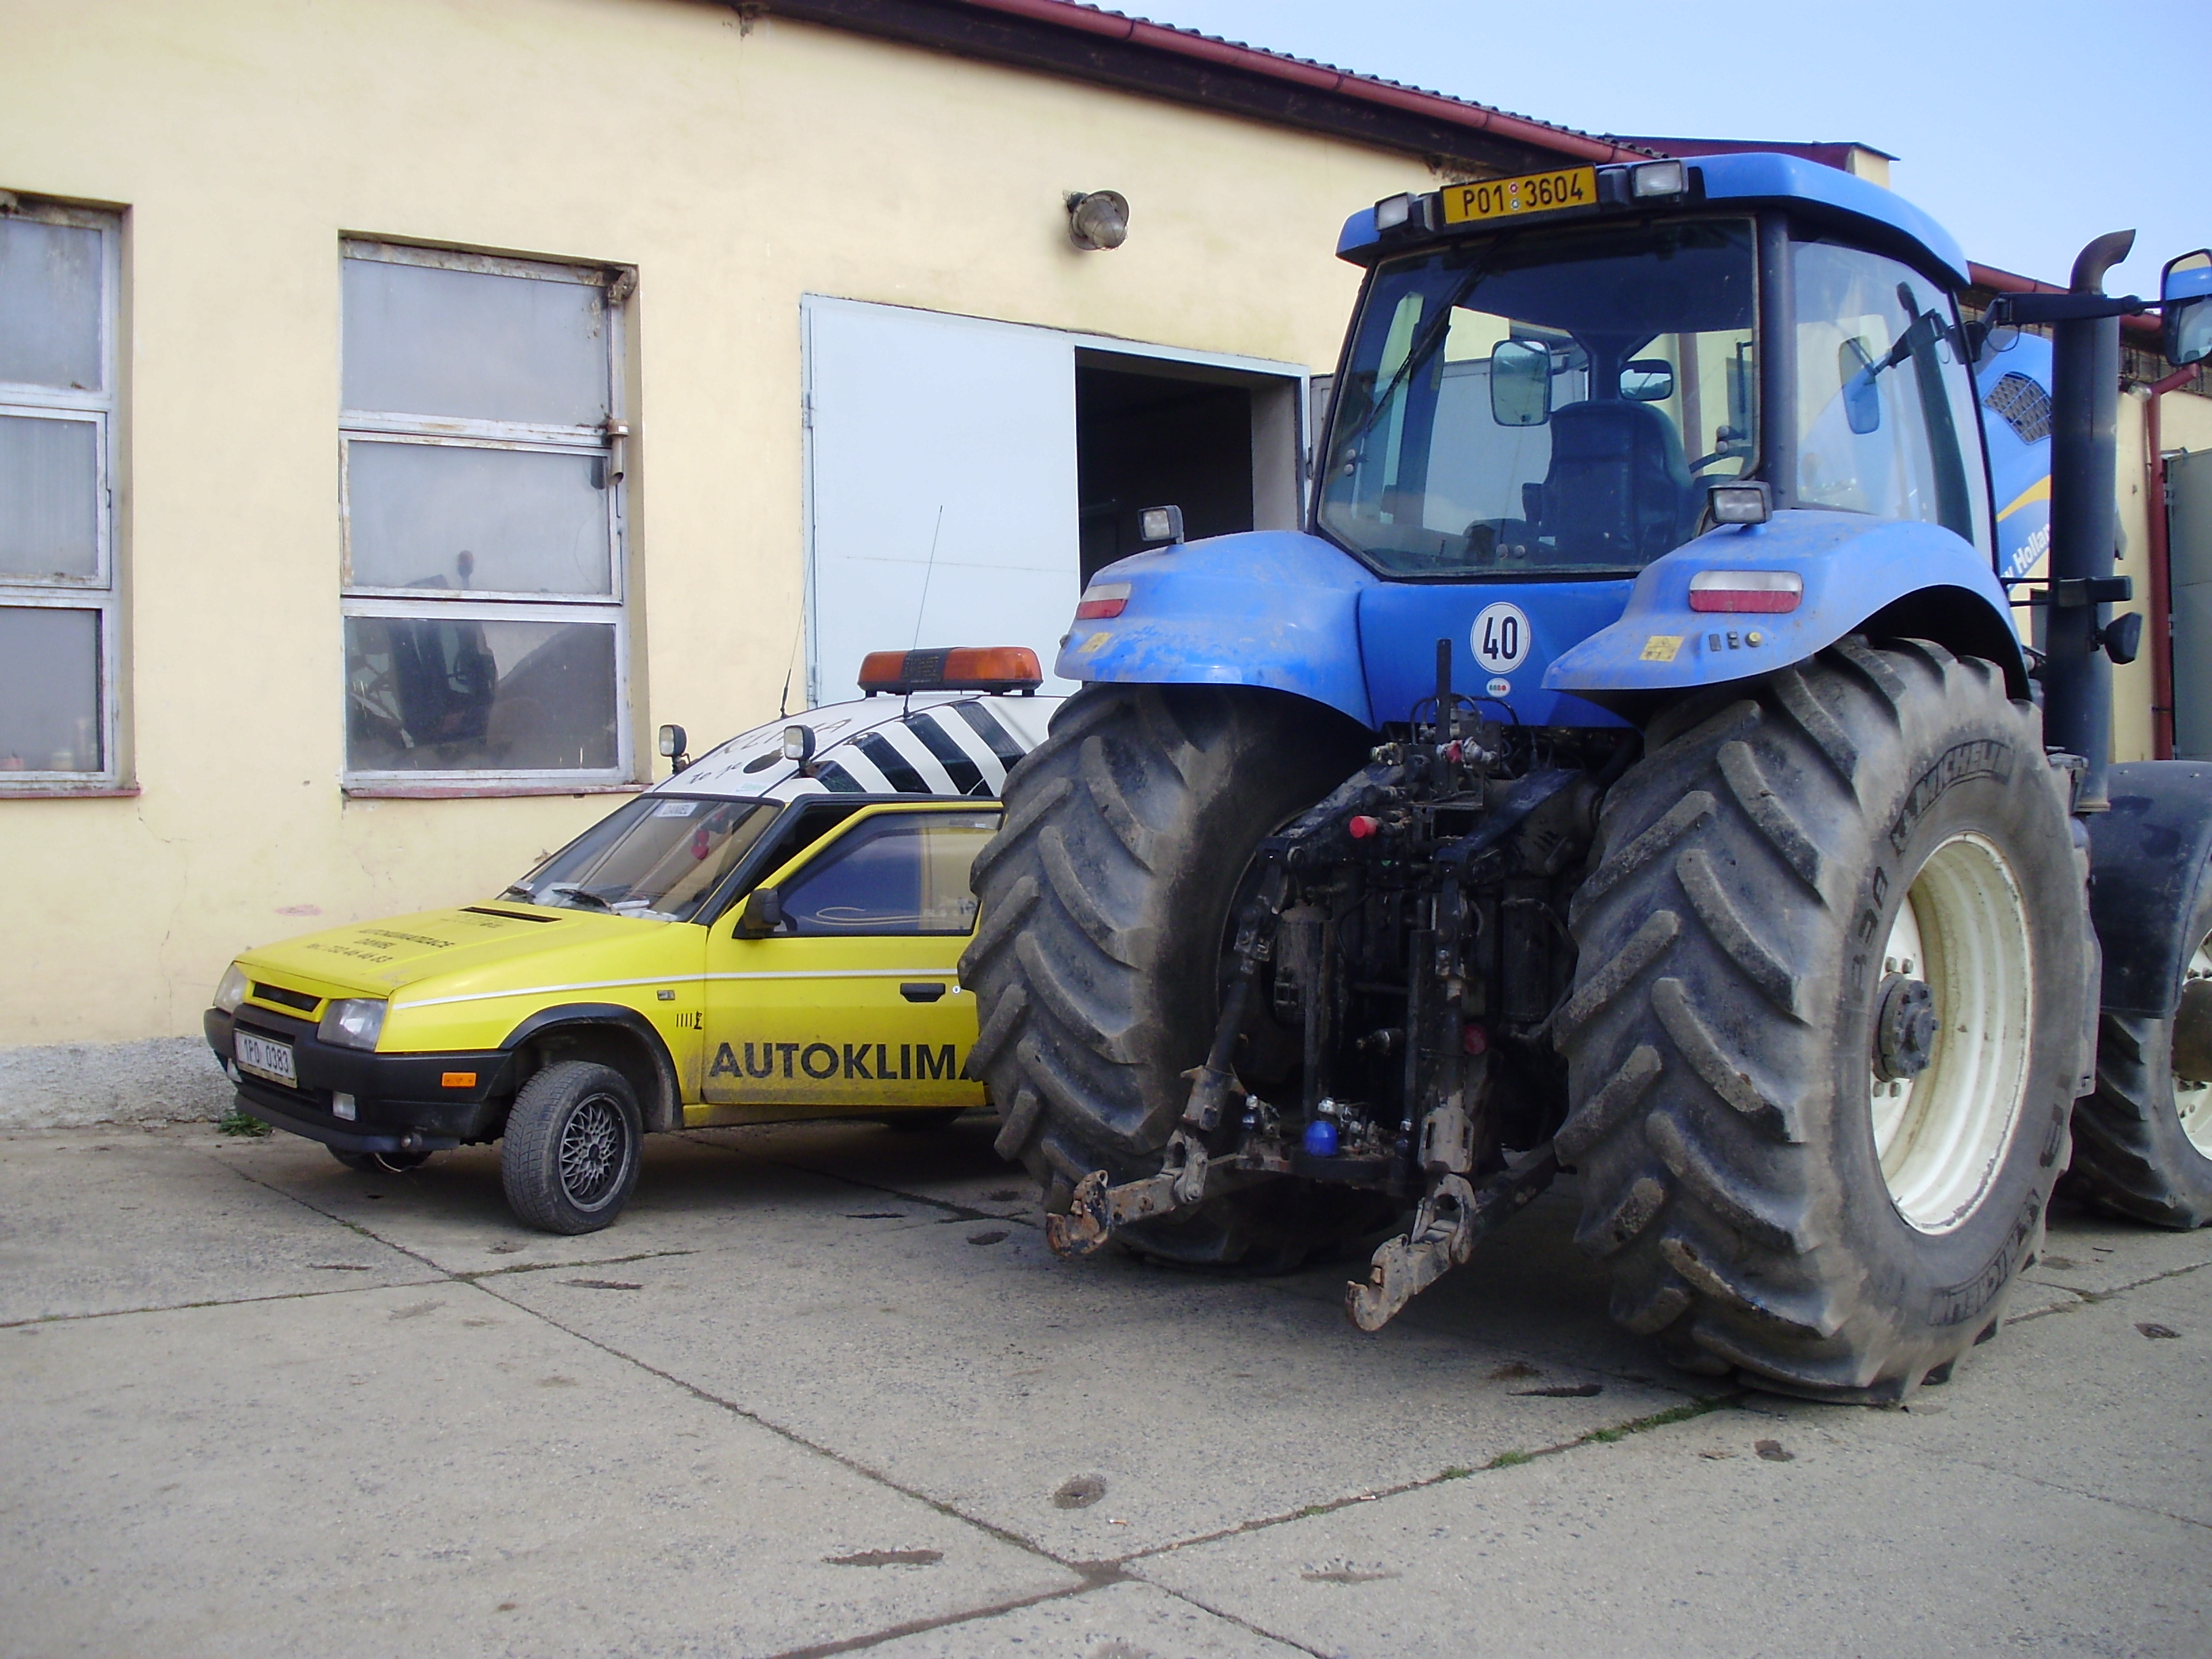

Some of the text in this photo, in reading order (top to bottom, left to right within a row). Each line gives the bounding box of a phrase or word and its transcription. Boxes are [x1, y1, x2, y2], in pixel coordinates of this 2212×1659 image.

[1524, 173, 1584, 207] 3604
[2012, 524, 2049, 574] Holla
[1482, 616, 1518, 660] 40
[266, 1044, 289, 1073] 0383
